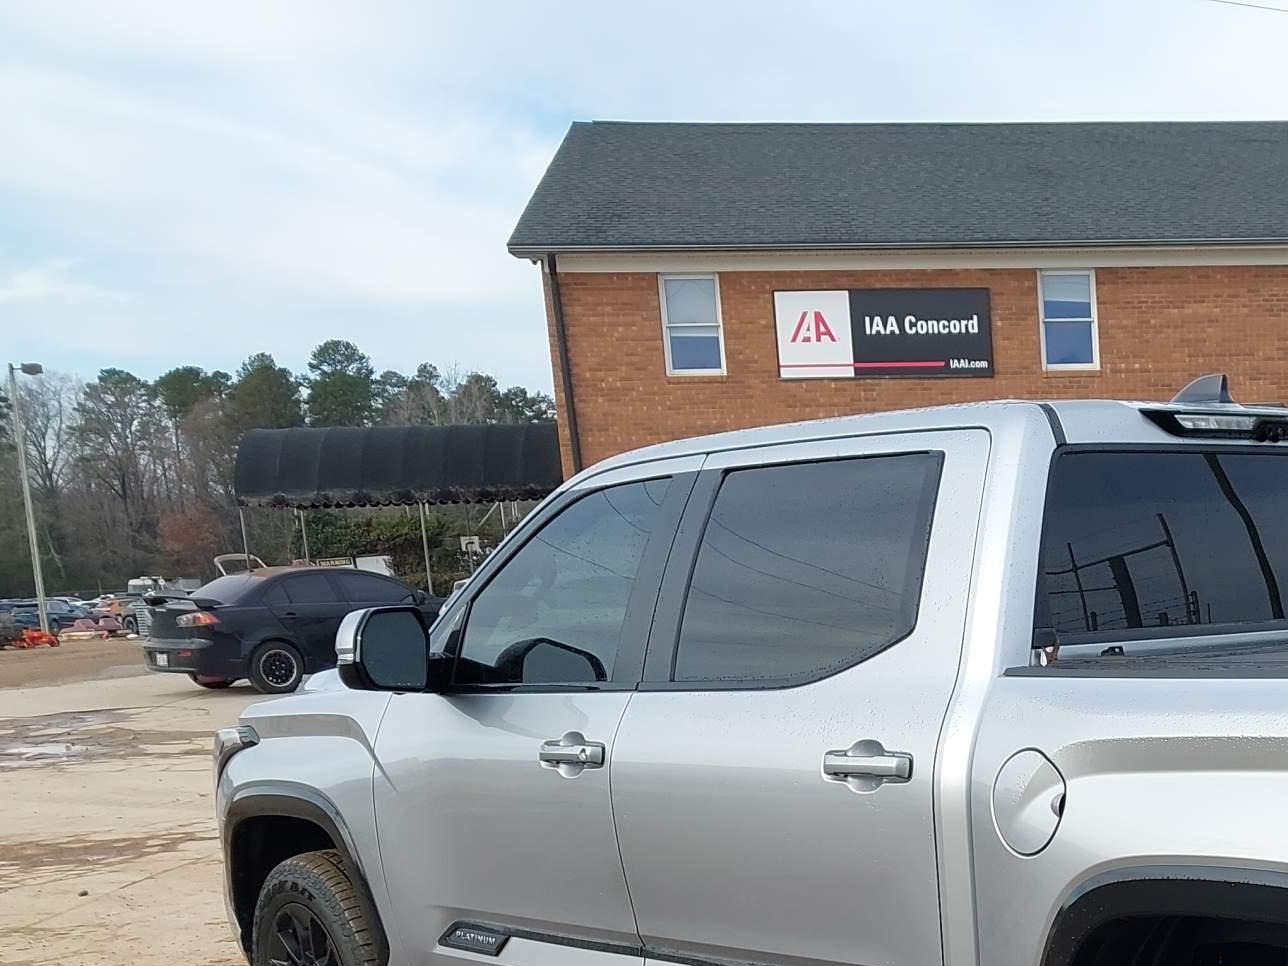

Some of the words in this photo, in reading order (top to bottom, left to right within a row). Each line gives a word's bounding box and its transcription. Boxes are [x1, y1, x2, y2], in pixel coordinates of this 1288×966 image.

[864, 316, 900, 335] IAA
[904, 314, 979, 335] Concord
[949, 358, 989, 369] IAAI.com
[455, 930, 496, 945] PLATINUM
